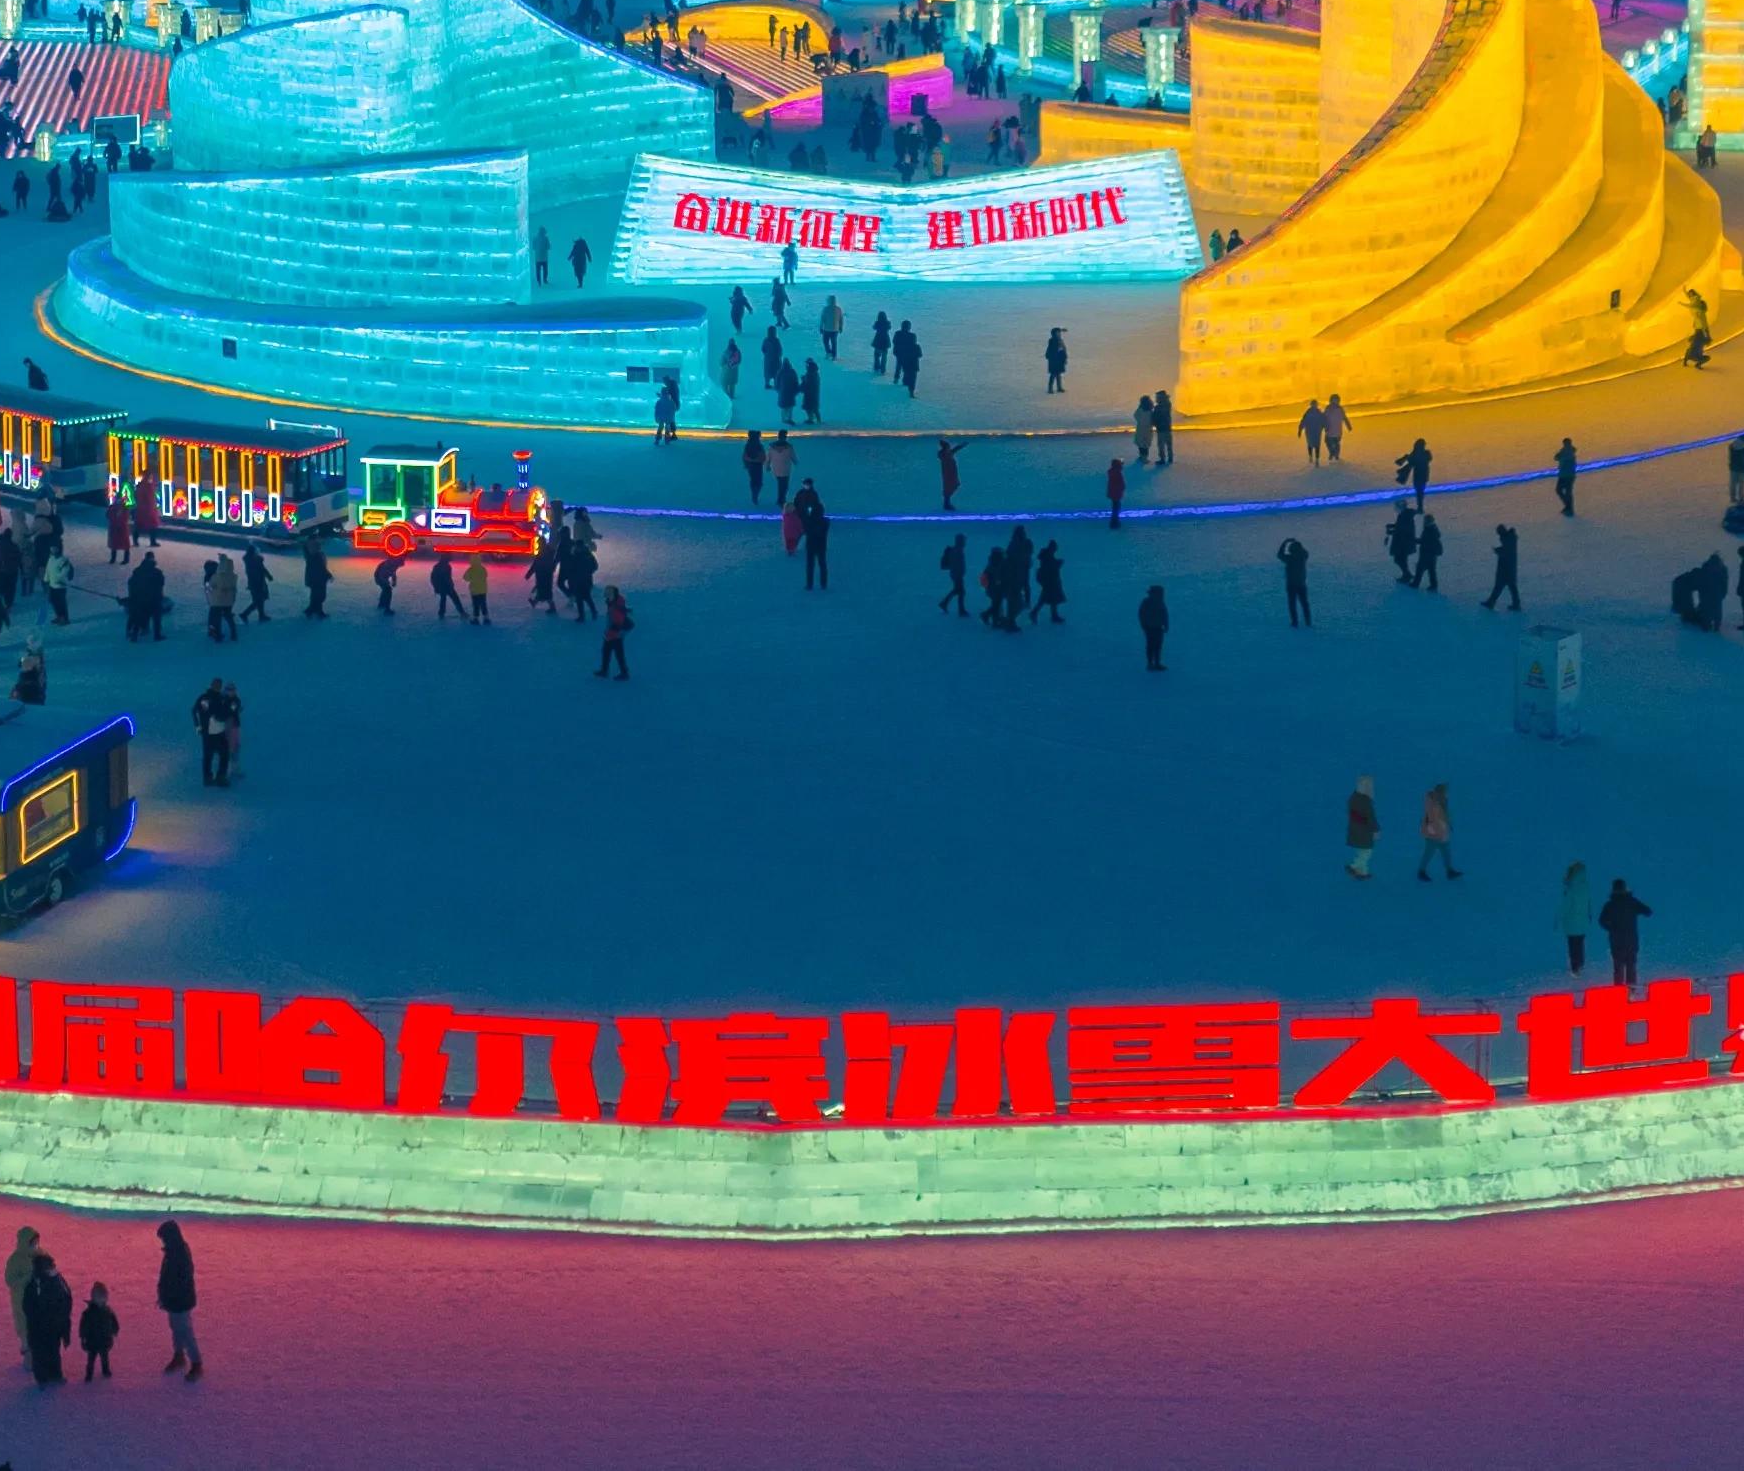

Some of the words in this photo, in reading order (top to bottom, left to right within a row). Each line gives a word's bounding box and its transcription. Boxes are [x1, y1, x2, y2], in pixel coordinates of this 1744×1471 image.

[673, 192, 882, 252] 奋进新征程
[927, 186, 1129, 250] 建功新时代
